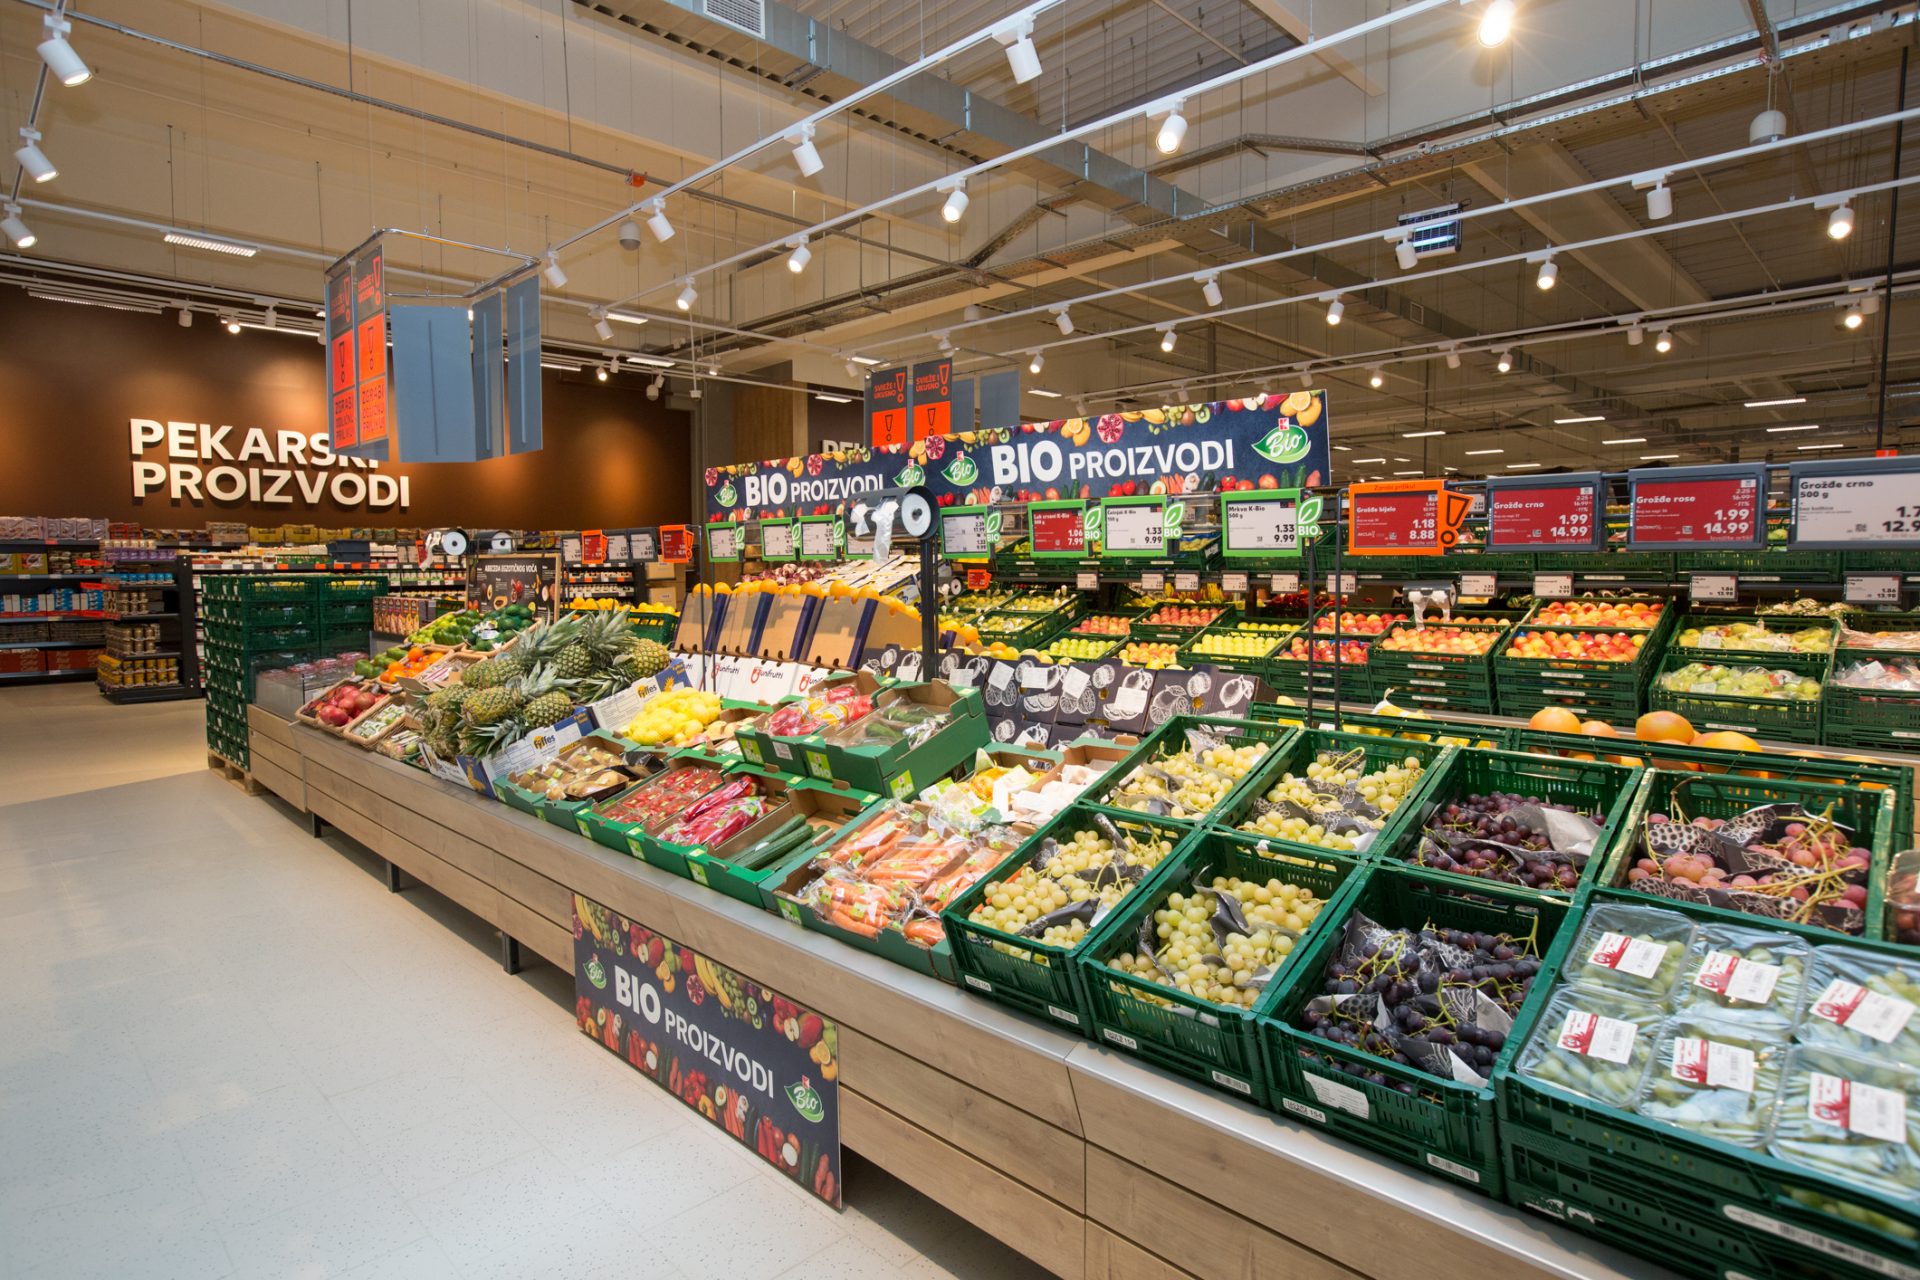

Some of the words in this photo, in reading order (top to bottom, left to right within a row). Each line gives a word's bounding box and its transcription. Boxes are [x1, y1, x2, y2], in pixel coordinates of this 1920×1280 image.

[130, 418, 378, 469] PEKARS
[1266, 432, 1302, 458] Bio
[991, 440, 1062, 486] BIO
[1069, 439, 1234, 480] PROIZVODI
[952, 461, 974, 478] Bio
[132, 461, 410, 508] PROIZVODI
[745, 473, 788, 507] BIO
[790, 474, 884, 503] PROIZVODI
[1800, 481, 1842, 490] Grožđe
[1846, 480, 1874, 488] crno
[1636, 496, 1671, 504] Grožđe
[1559, 514, 1588, 525] 1.99
[1715, 509, 1750, 520] 1.99
[1275, 524, 1295, 533] 1.33
[1412, 519, 1435, 528] 1.18
[1704, 523, 1749, 534] 14.99
[1084, 530, 1100, 540] BIO
[1146, 527, 1162, 535] 1.33
[1164, 528, 1181, 537] BIO
[1298, 525, 1318, 536] BIO
[1410, 530, 1435, 540] 8.88
[1550, 526, 1588, 537] 14.99
[1274, 534, 1295, 543] 9.99
[760, 669, 784, 679] unifrutti
[638, 684, 657, 696] fyffes
[534, 734, 556, 750] fyffes
[812, 764, 831, 778] Bio
[895, 783, 913, 800] Bio
[588, 962, 603, 980] Bio
[614, 965, 661, 1024] BIO
[664, 1008, 774, 1099] PROIZVODI
[793, 1086, 818, 1110] Bio
